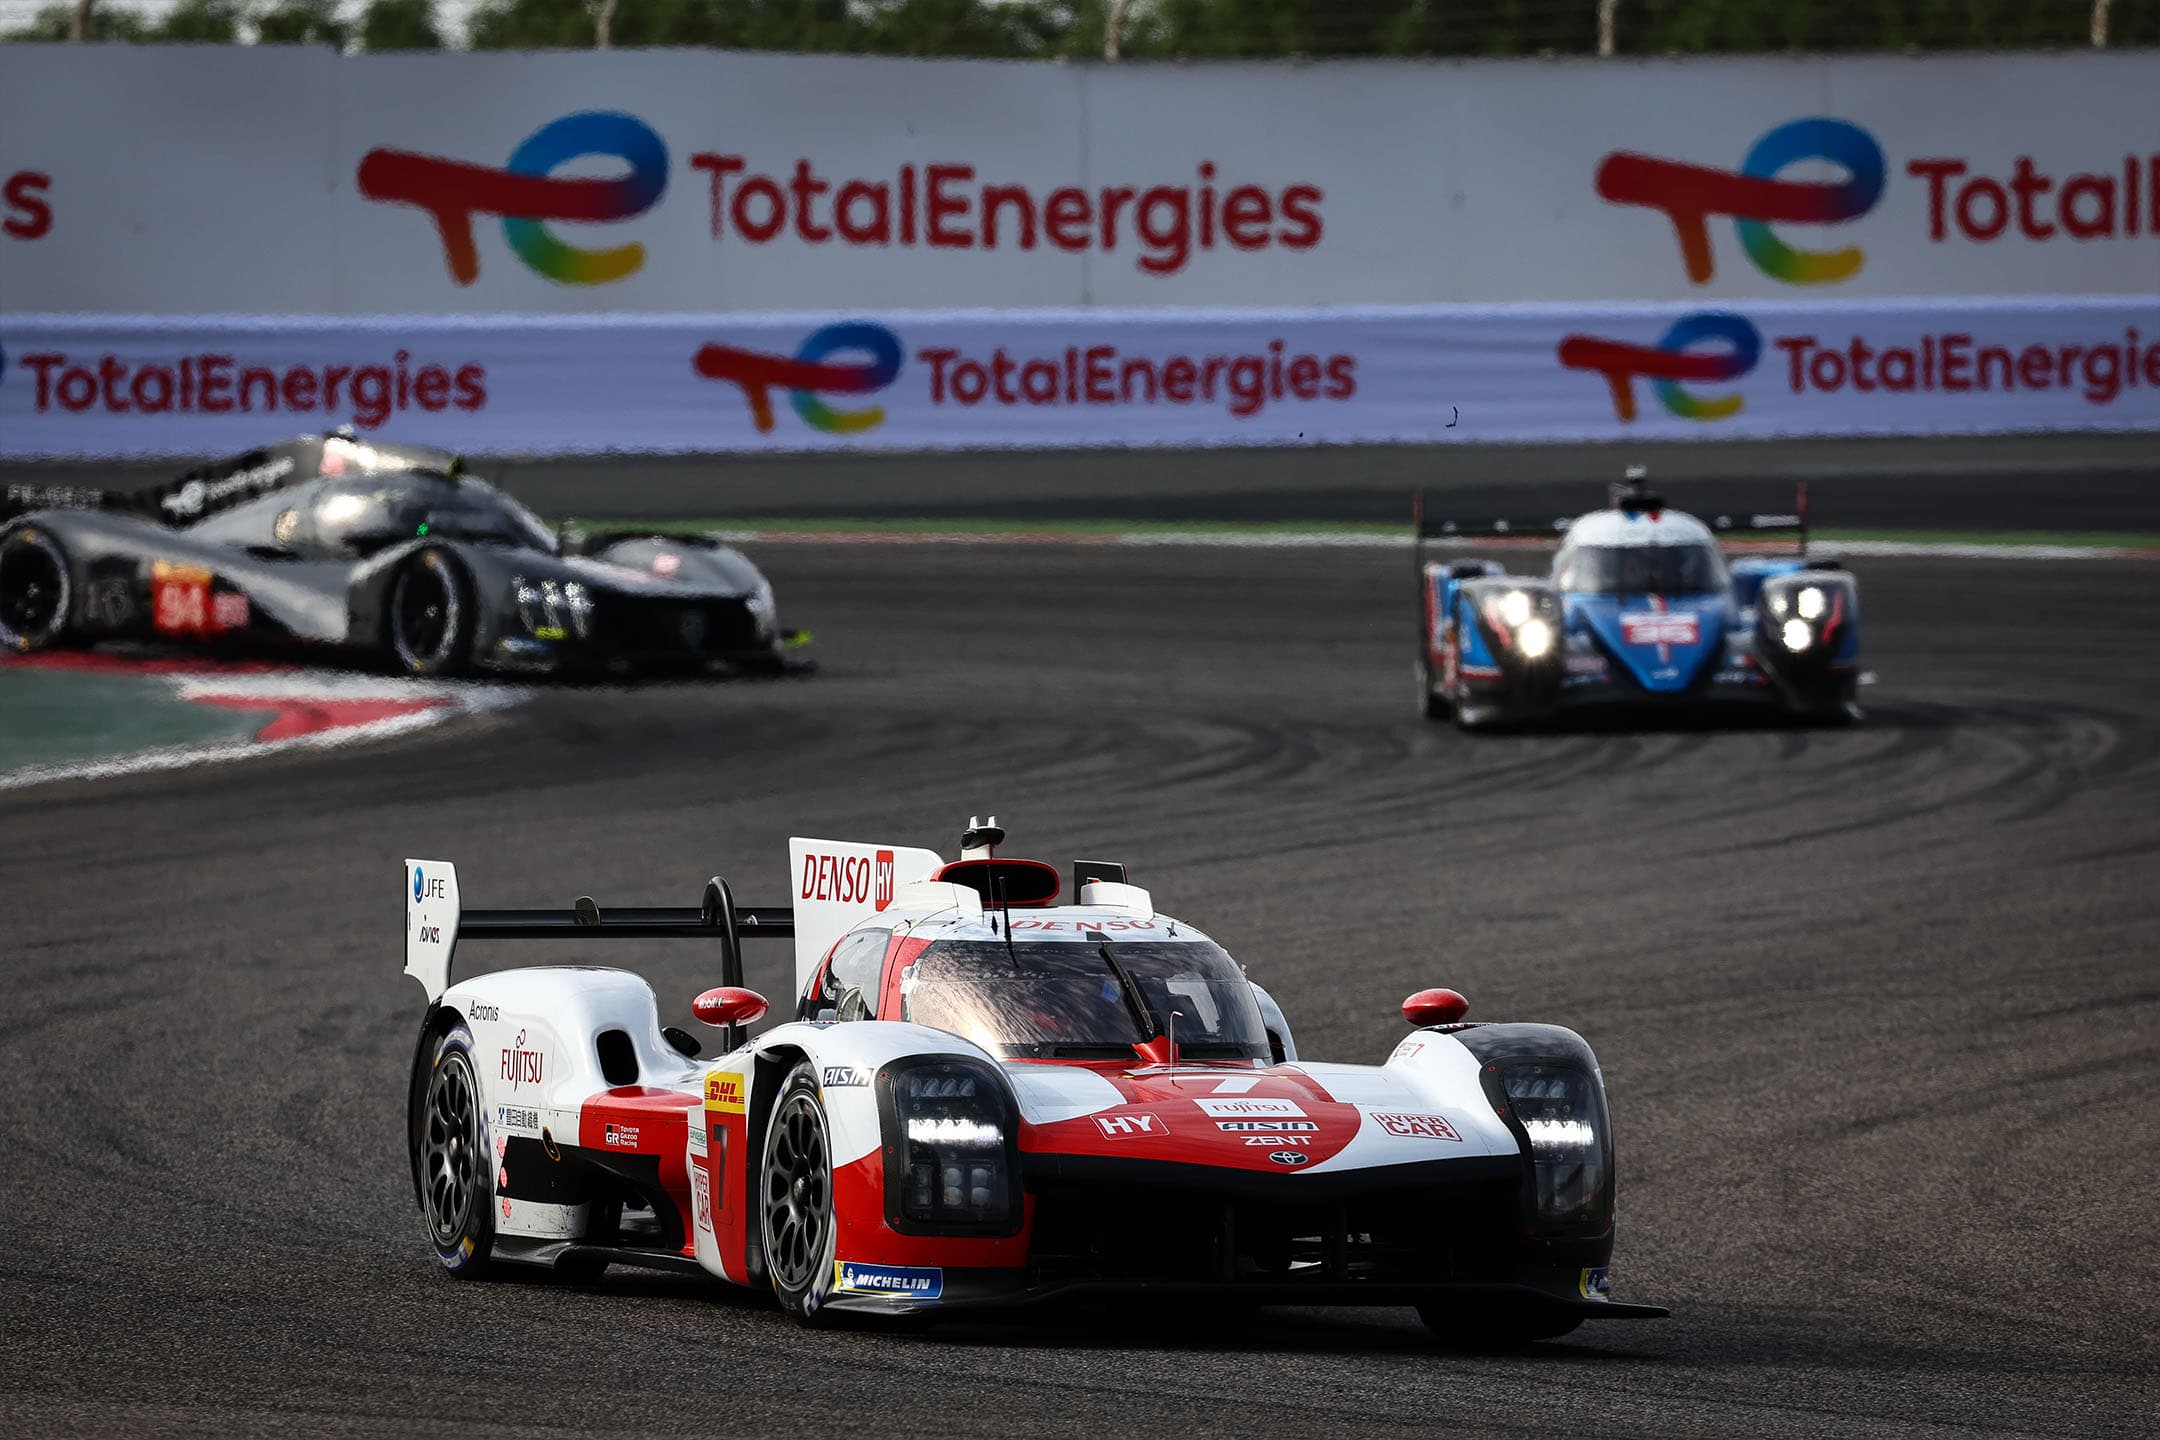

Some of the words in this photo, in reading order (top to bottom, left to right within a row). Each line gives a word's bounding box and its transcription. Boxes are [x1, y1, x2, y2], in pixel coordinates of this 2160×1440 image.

[1906, 154, 2160, 241] Total
[690, 152, 1324, 275] TotalEnergies
[918, 339, 1357, 417] TotalEnergies
[22, 350, 487, 429] TotalEnergies
[425, 878, 445, 899] JFE
[802, 854, 869, 904] DENSO
[876, 859, 893, 902] HY
[1009, 919, 1155, 932] DENSO
[468, 1000, 499, 1022] Acronis
[501, 1048, 543, 1092] FUJITSU
[824, 1066, 870, 1087] AISIN
[709, 1080, 738, 1103] DHL
[1212, 1104, 1290, 1113] FUJITSU
[1106, 1115, 1152, 1134] HY
[1222, 1122, 1314, 1130] AISIN
[1378, 1112, 1444, 1127] HYPER
[1386, 1121, 1456, 1138] CAR
[606, 1132, 619, 1144] GR
[1240, 1135, 1312, 1146] ZENT
[714, 1124, 727, 1210] 7
[856, 1274, 931, 1290] MICHELIN
